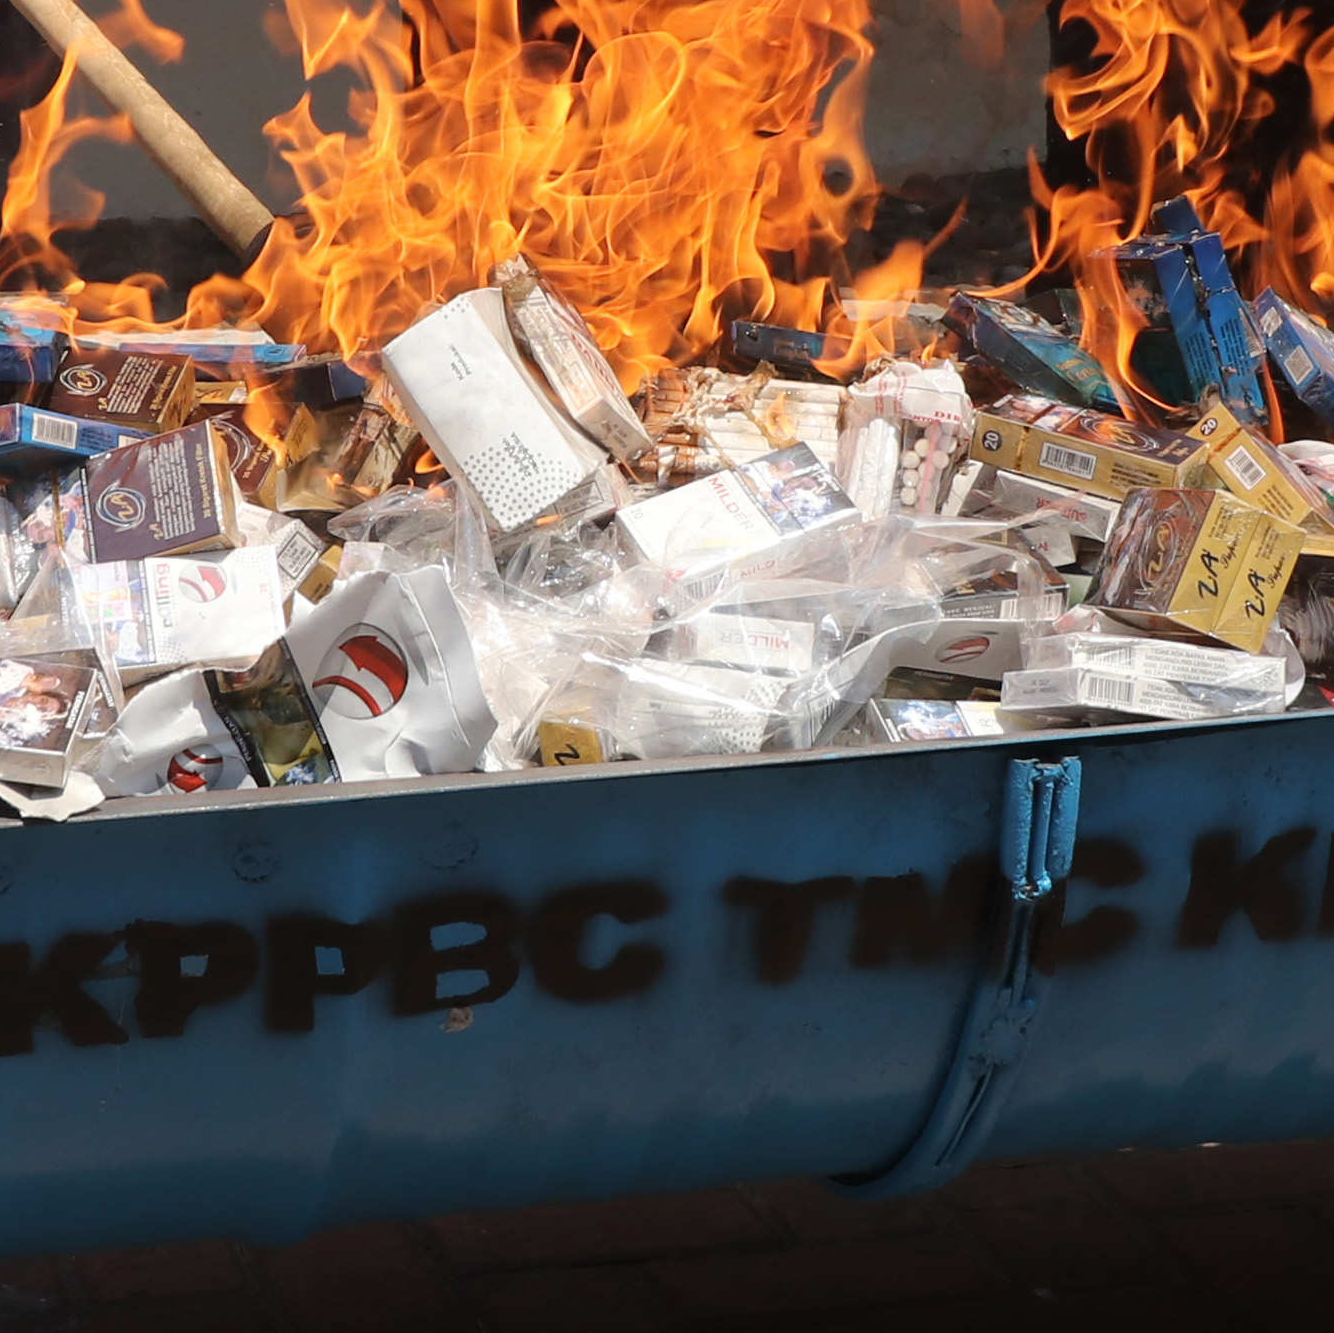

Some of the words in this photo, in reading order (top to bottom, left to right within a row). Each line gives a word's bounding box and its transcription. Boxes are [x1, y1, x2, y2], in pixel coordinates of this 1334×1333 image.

[1201, 419, 1217, 435] 20
[985, 433, 1000, 450] 20
[707, 475, 754, 532] MILDER
[719, 632, 790, 651] MILDER
[66, 691, 85, 729] PERINGATAN
